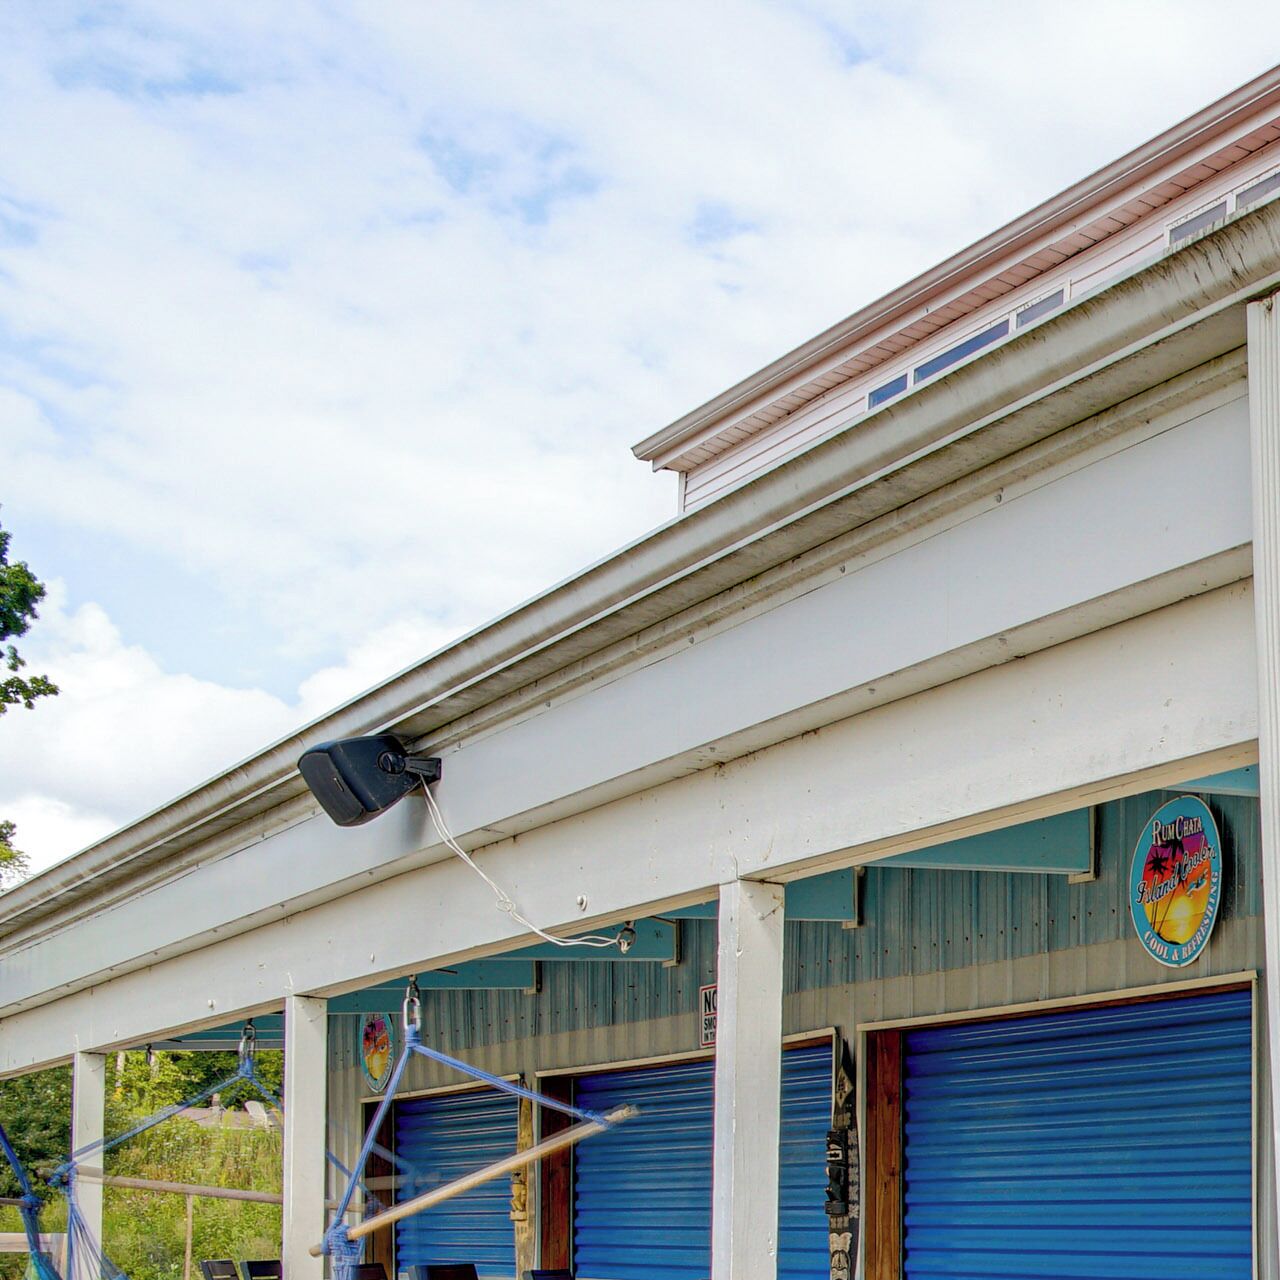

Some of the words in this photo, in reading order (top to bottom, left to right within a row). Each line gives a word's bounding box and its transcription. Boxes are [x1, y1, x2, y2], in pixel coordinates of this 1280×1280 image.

[1136, 861, 1180, 904] Island
[1182, 834, 1216, 880] Coolers
[1144, 930, 1169, 960] COOL
[1171, 948, 1179, 961] &
[1182, 872, 1218, 960] REFRESHING
